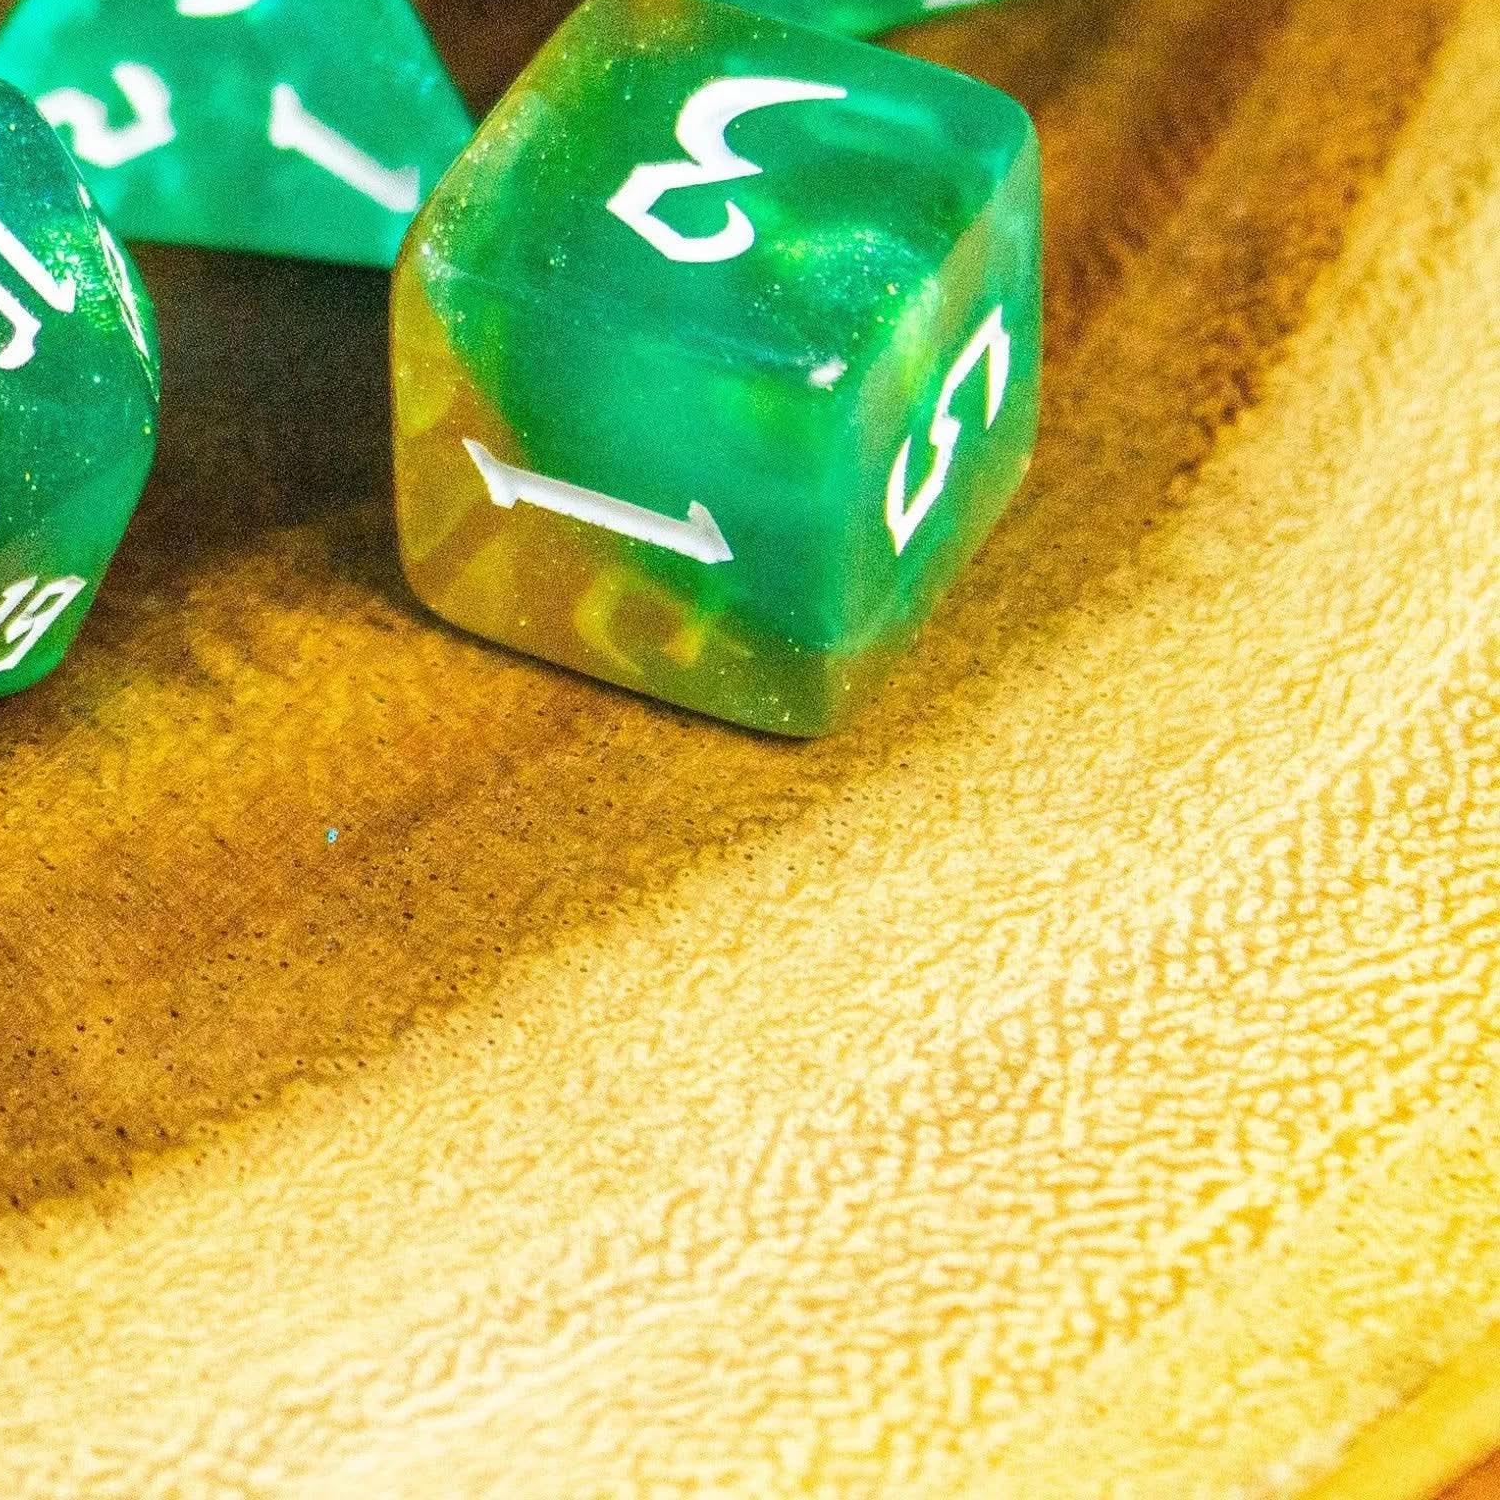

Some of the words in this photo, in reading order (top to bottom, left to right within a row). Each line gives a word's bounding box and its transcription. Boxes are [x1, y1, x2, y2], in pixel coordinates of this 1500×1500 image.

[36, 62, 176, 168] 2
[268, 82, 422, 214] 1
[606, 74, 848, 264] 3
[884, 302, 1012, 558] 5
[460, 436, 736, 566] 1
